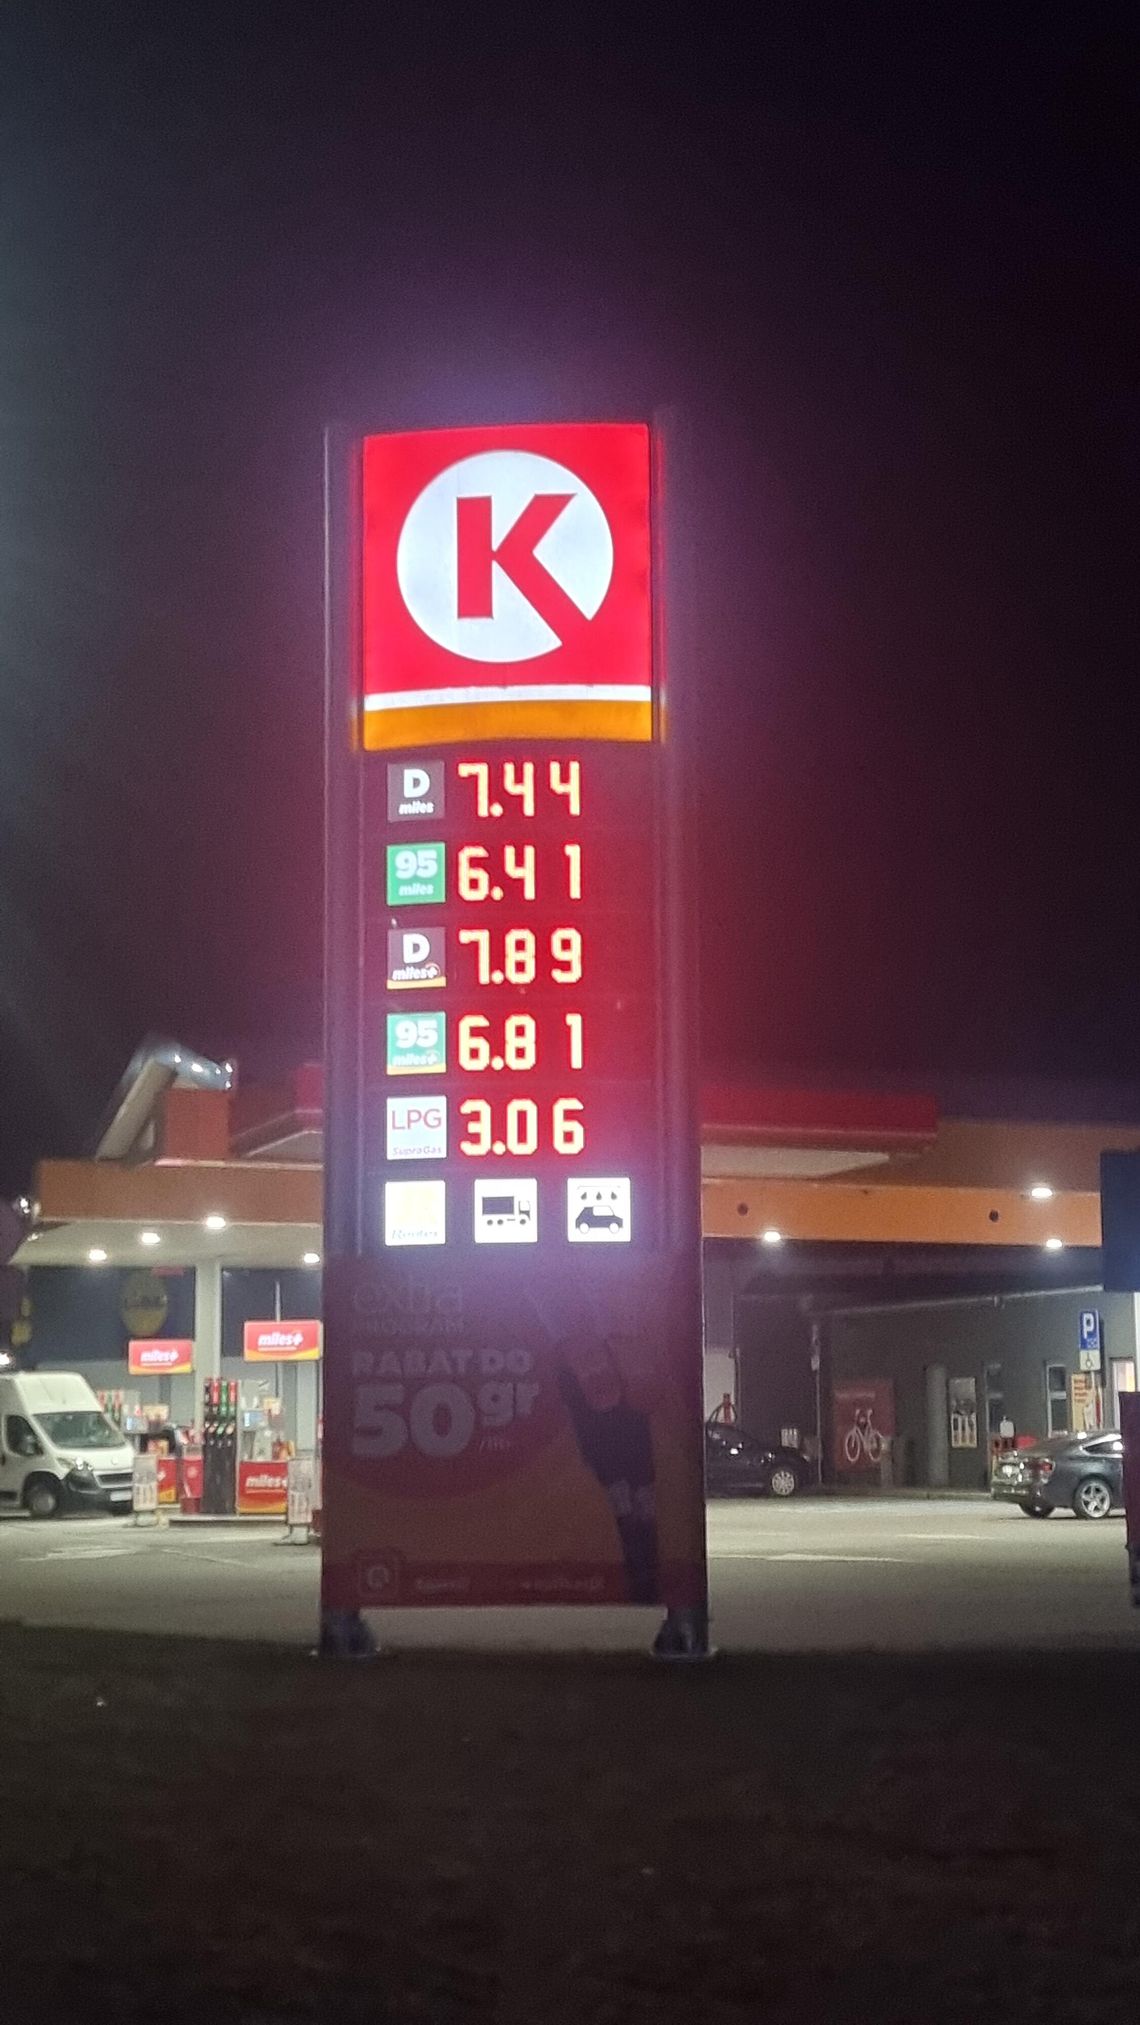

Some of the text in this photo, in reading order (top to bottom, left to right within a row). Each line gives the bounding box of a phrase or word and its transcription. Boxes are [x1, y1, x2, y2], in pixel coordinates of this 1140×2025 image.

[456, 493, 592, 645] K
[403, 768, 430, 798] D
[458, 761, 581, 817] 7.44
[399, 801, 434, 814] miles
[395, 850, 438, 879] 95
[458, 844, 581, 901] 6.41
[399, 883, 434, 896] miles
[403, 933, 430, 963] D
[459, 928, 582, 985] 7.89
[395, 1019, 438, 1048] 95
[459, 1013, 583, 1071] 6.81
[392, 1108, 441, 1131] LPG
[460, 1098, 584, 1156] 3.06
[1083, 1312, 1095, 1340] P
[352, 1348, 533, 1377] RABAT DO
[351, 1381, 540, 1458] 50 gr
